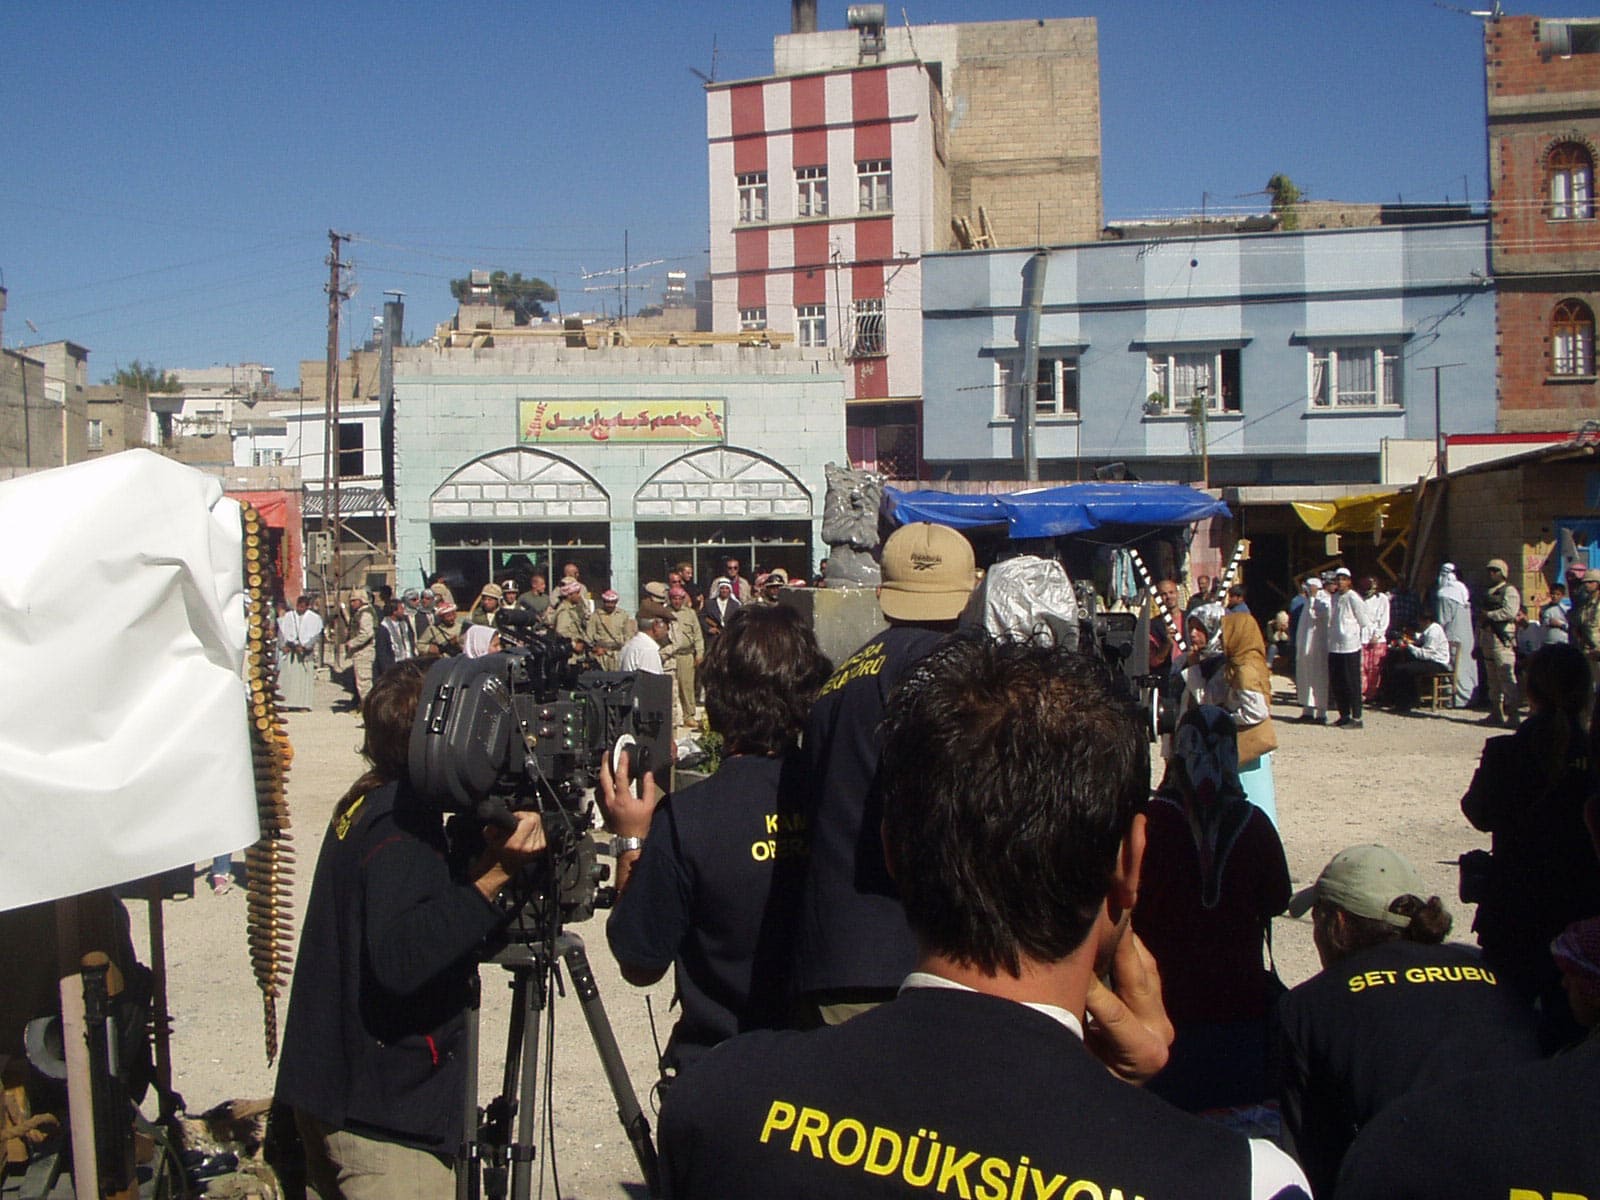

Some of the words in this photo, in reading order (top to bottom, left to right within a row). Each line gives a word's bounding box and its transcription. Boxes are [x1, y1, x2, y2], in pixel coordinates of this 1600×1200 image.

[1348, 970, 1398, 992] SET
[1405, 965, 1497, 986] GRUBU
[760, 1100, 1145, 1200] PRODÜKSİY
